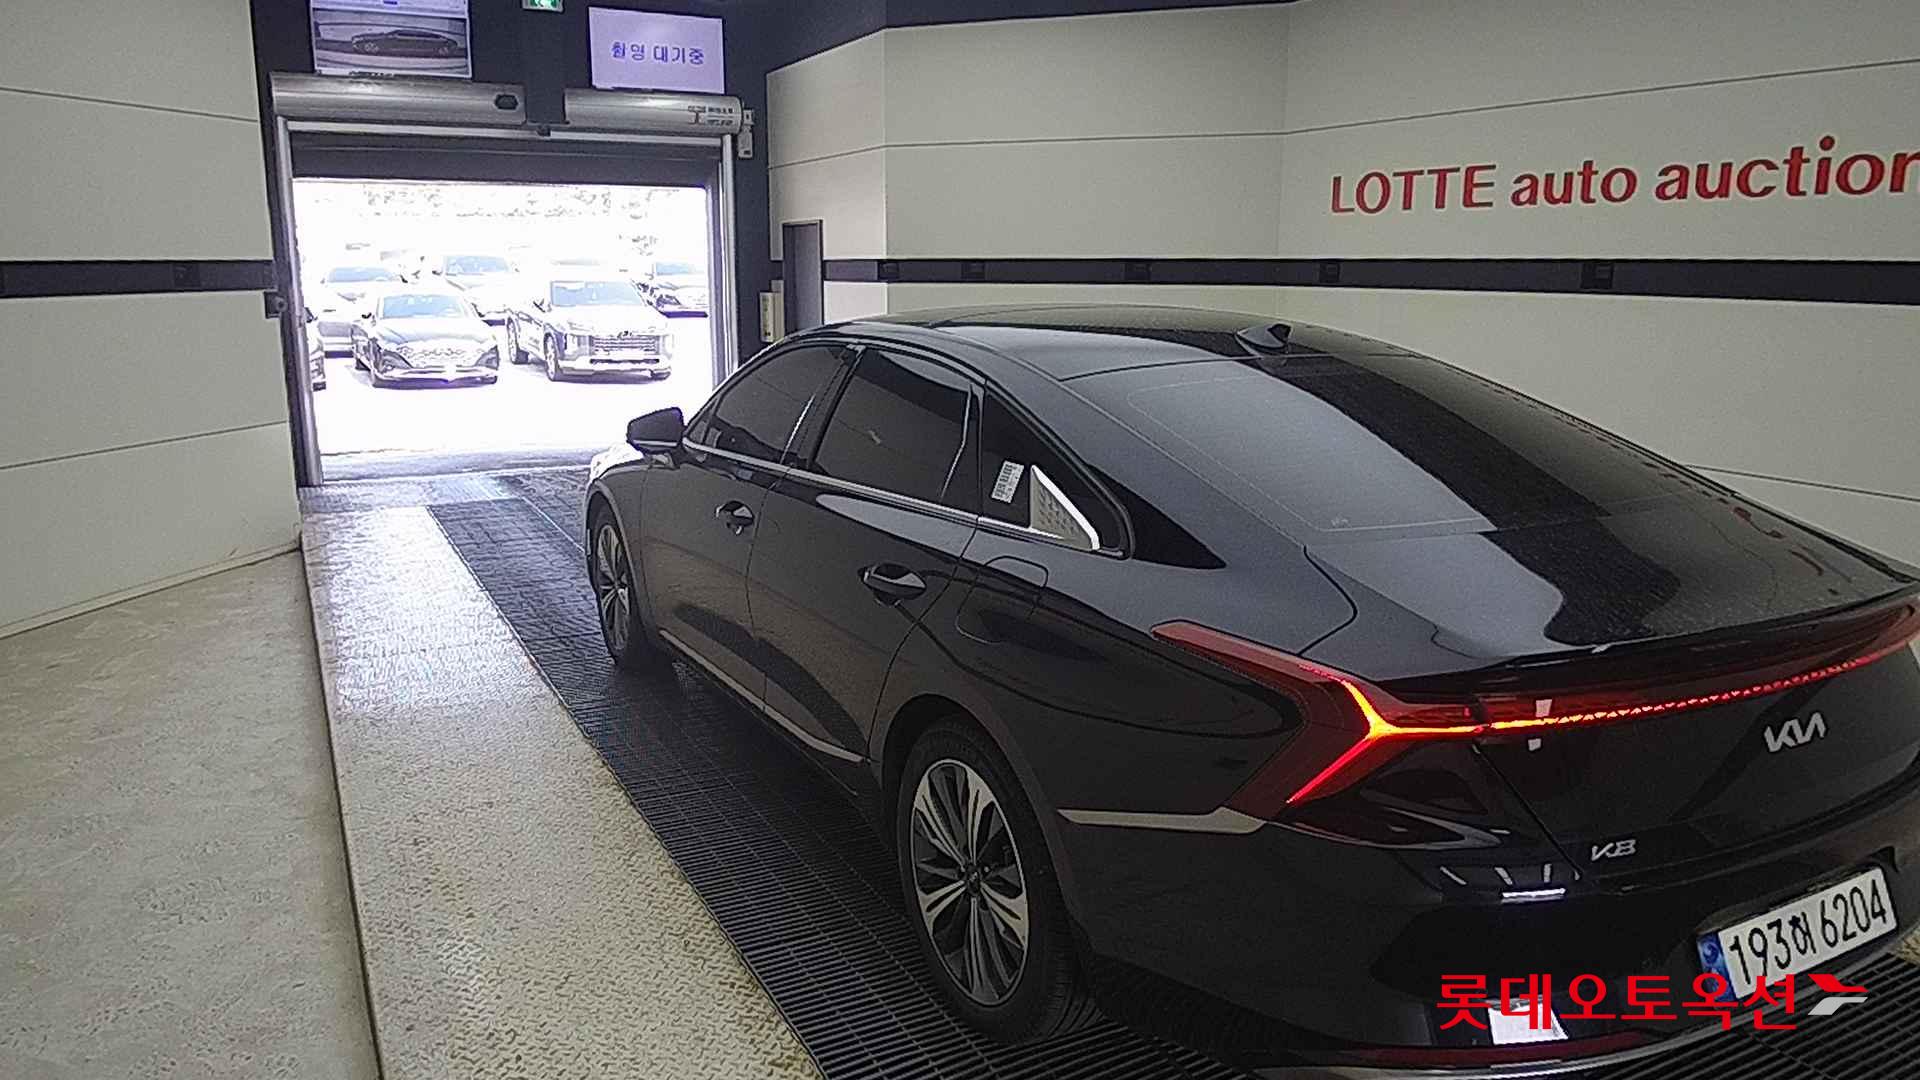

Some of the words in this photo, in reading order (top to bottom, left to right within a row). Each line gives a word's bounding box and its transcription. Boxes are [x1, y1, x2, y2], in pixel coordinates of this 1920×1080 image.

[653, 45, 704, 65] 대기중
[1331, 164, 1496, 214] LOTTE
[1510, 160, 1638, 206] auto
[1654, 135, 1920, 201] auction
[1764, 712, 1827, 752] KIA
[1591, 839, 1637, 862] K8
[1729, 911, 1817, 985] 193허
[1820, 879, 1887, 948] 6204
